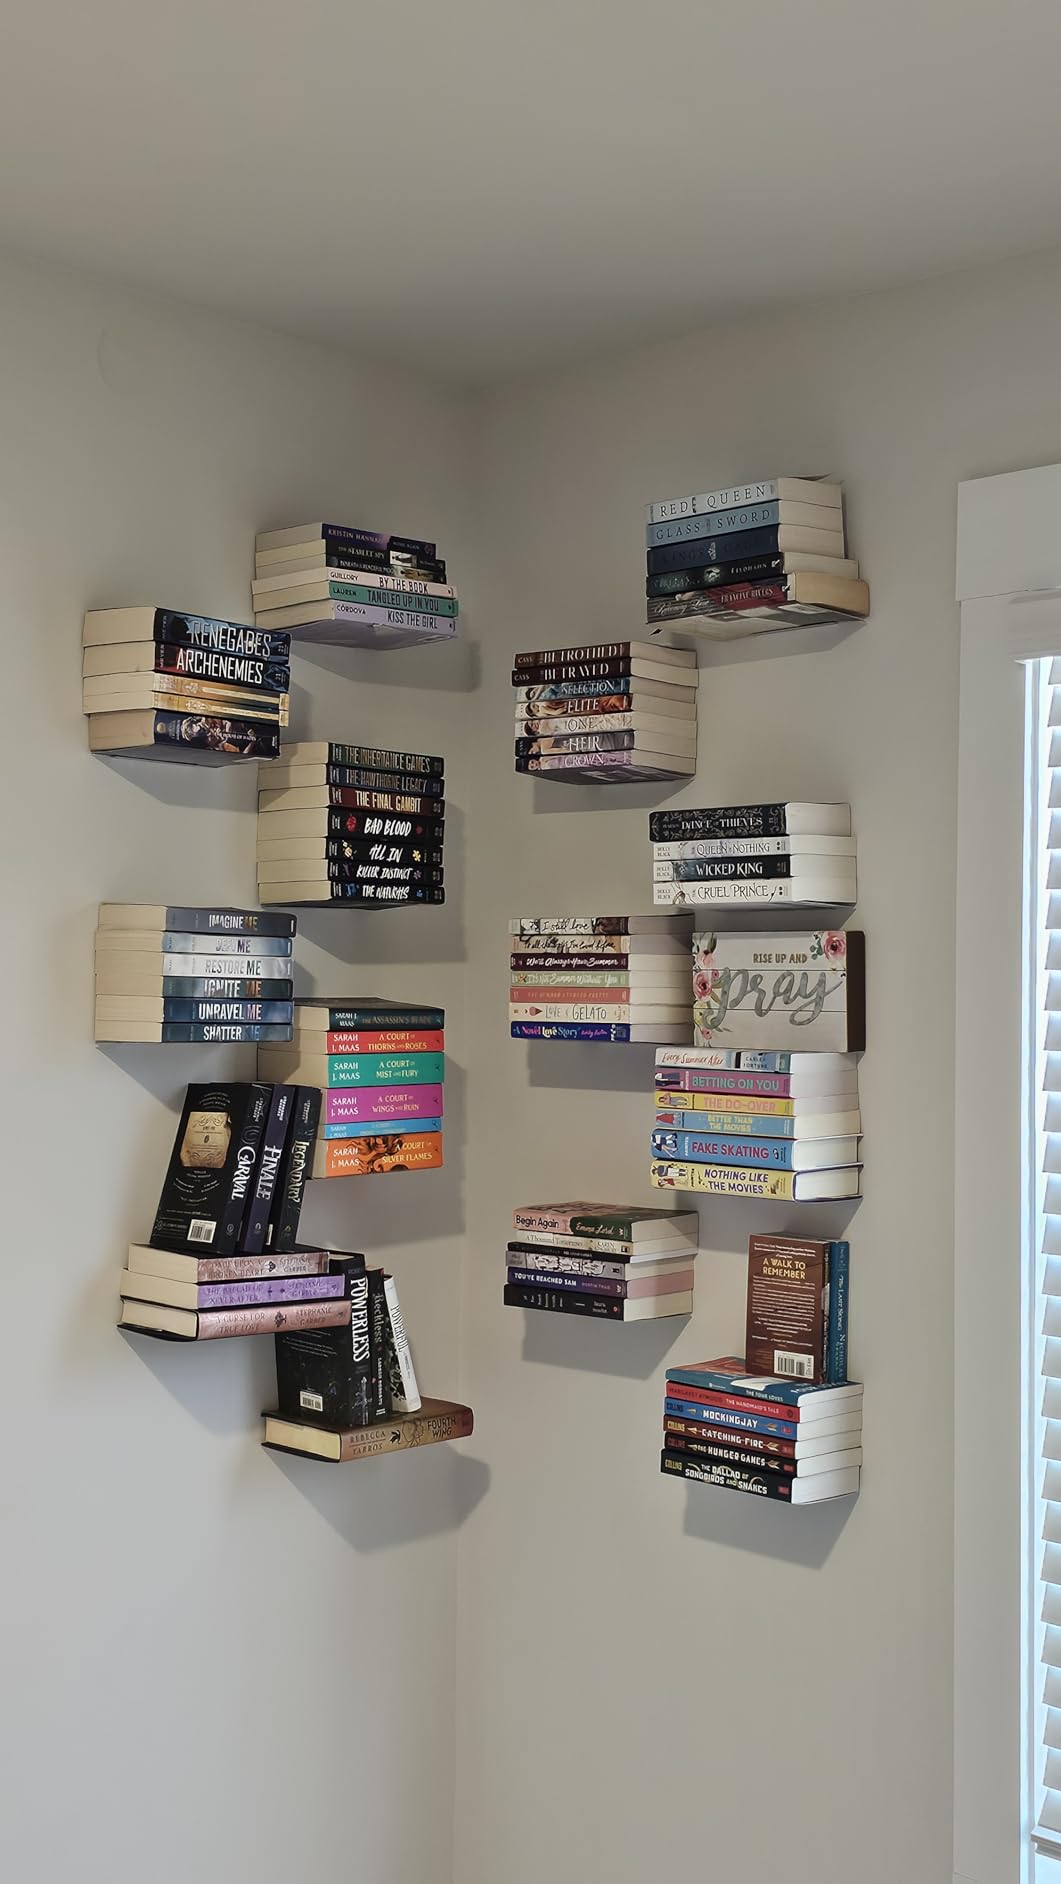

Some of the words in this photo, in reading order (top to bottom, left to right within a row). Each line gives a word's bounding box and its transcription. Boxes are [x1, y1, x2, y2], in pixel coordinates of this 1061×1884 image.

[660, 502, 688, 516] RED
[708, 485, 765, 508] QUEEN
[656, 522, 700, 540] GLASS
[718, 509, 770, 528] SWORD
[328, 529, 353, 538] KRISTIN
[330, 572, 358, 580] GUILLORY
[333, 588, 356, 596] LAUREN
[380, 577, 388, 588] BY
[392, 579, 406, 590] THE
[409, 582, 428, 594] BOOK
[368, 590, 400, 606] TANGLED
[403, 594, 412, 606] UP
[414, 596, 424, 608] IN
[424, 598, 438, 612] YOU
[388, 610, 404, 624] KISS
[406, 614, 420, 626] THE
[422, 616, 438, 629] GIRL
[191, 620, 272, 657] RENEGADES
[176, 648, 264, 684] ARCHENEMIES
[562, 680, 615, 694] SELECTION
[568, 698, 599, 714] ELITE
[568, 717, 598, 732] ONE
[568, 736, 602, 752] HEIR
[345, 746, 358, 764] THE
[362, 748, 404, 770] INHERITANCE
[406, 755, 430, 772] GAMES
[564, 752, 605, 768] CROWN
[346, 769, 358, 784] THE
[360, 770, 400, 790] HAWTHORNE
[402, 778, 427, 792] LEGACY
[355, 790, 370, 807] THE
[372, 792, 394, 810] FINAL
[396, 796, 421, 812] GAMBIT
[364, 818, 382, 834] BAD
[384, 819, 412, 836] BLOOD
[682, 820, 712, 830] DANCE
[720, 818, 762, 828] THIEVES
[369, 844, 386, 860] ALL
[386, 848, 403, 862] IN
[697, 844, 728, 858] QUEEN
[732, 842, 770, 854] NOTHING
[356, 865, 379, 878] KILLER
[380, 867, 413, 880] INSTINCT
[696, 863, 735, 876] WICKED
[736, 862, 762, 877] KING
[362, 885, 374, 897] THE
[376, 886, 410, 900] NATURALS
[697, 886, 730, 898] CRUEL
[731, 883, 768, 900] PRINCE
[209, 914, 244, 929] IMAGINE
[245, 916, 258, 930] ME
[238, 940, 250, 952] ME
[753, 953, 772, 964] RISE
[775, 953, 786, 964] UP
[789, 953, 808, 964] AND
[206, 960, 245, 974] RESTORE
[246, 960, 262, 975] ME
[204, 980, 241, 998] IGNITE
[246, 981, 262, 997] ME
[703, 967, 843, 1029] pray
[199, 1004, 244, 1020] UNRAVEL
[247, 1004, 262, 1020] ME
[545, 1006, 560, 1018] LOVE
[572, 1004, 606, 1020] GELATO
[204, 1026, 242, 1040] SHATTER
[334, 1034, 358, 1042] SARAH
[542, 1026, 558, 1038] Love
[558, 1027, 580, 1038] Story
[338, 1044, 360, 1052] MAAS
[334, 1062, 358, 1070] SARAH
[386, 1060, 410, 1068] COURT
[662, 1052, 680, 1064] Every
[680, 1054, 707, 1064] Summer
[708, 1054, 724, 1065] After
[339, 1072, 360, 1080] MAAS
[376, 1070, 392, 1078] MIST
[692, 1076, 736, 1088] BETTING
[738, 1078, 754, 1089] ON
[756, 1079, 780, 1090] YOU
[332, 1098, 357, 1106] SARAH
[385, 1094, 408, 1102] COURT
[704, 1098, 722, 1108] THE
[726, 1099, 776, 1112] DO-OVER
[404, 1104, 419, 1112] RUIN
[708, 1114, 732, 1122] BETTER
[734, 1116, 752, 1124] THAN
[710, 1122, 722, 1130] THE
[724, 1124, 752, 1132] MOVIES
[334, 1148, 358, 1157] SARAH
[402, 1142, 424, 1150] COURT
[692, 1142, 718, 1154] FAKE
[720, 1144, 769, 1158] SKATING
[338, 1158, 360, 1167] MAAS
[382, 1154, 405, 1163] SILVER
[406, 1152, 432, 1161] FLAMES
[231, 1146, 256, 1200] CARAVAL
[256, 1144, 283, 1200] FINALE
[288, 1140, 310, 1203] LEGENDARY
[704, 1168, 746, 1180] NOTHING
[748, 1171, 768, 1182] LIKE
[708, 1181, 726, 1190] THE
[728, 1182, 764, 1194] MOVIES
[516, 1214, 536, 1227] Begin
[538, 1217, 560, 1229] Again
[770, 1258, 792, 1268] WALK
[795, 1261, 806, 1270] TO
[514, 1272, 534, 1280] YOU'VE
[536, 1276, 562, 1284] REACHED
[762, 1266, 806, 1280] REMEMBER
[350, 1276, 370, 1362] POWERLESS
[373, 1293, 384, 1344] Reckless
[390, 1304, 408, 1352] POWERFUL
[428, 1416, 456, 1432] FOURTH
[703, 1410, 758, 1428] MOCKINGJAY
[350, 1431, 386, 1442] REBECCA
[432, 1428, 452, 1438] WING
[702, 1428, 742, 1444] CATCHING
[745, 1438, 764, 1448] FIRE
[352, 1442, 383, 1455] YARROS
[708, 1446, 739, 1460] HUNGER
[740, 1454, 766, 1466] GAMES
[712, 1466, 740, 1479] BALLAD
[685, 1468, 724, 1484] SONGBIRDS
[738, 1481, 767, 1494] SNAKES
